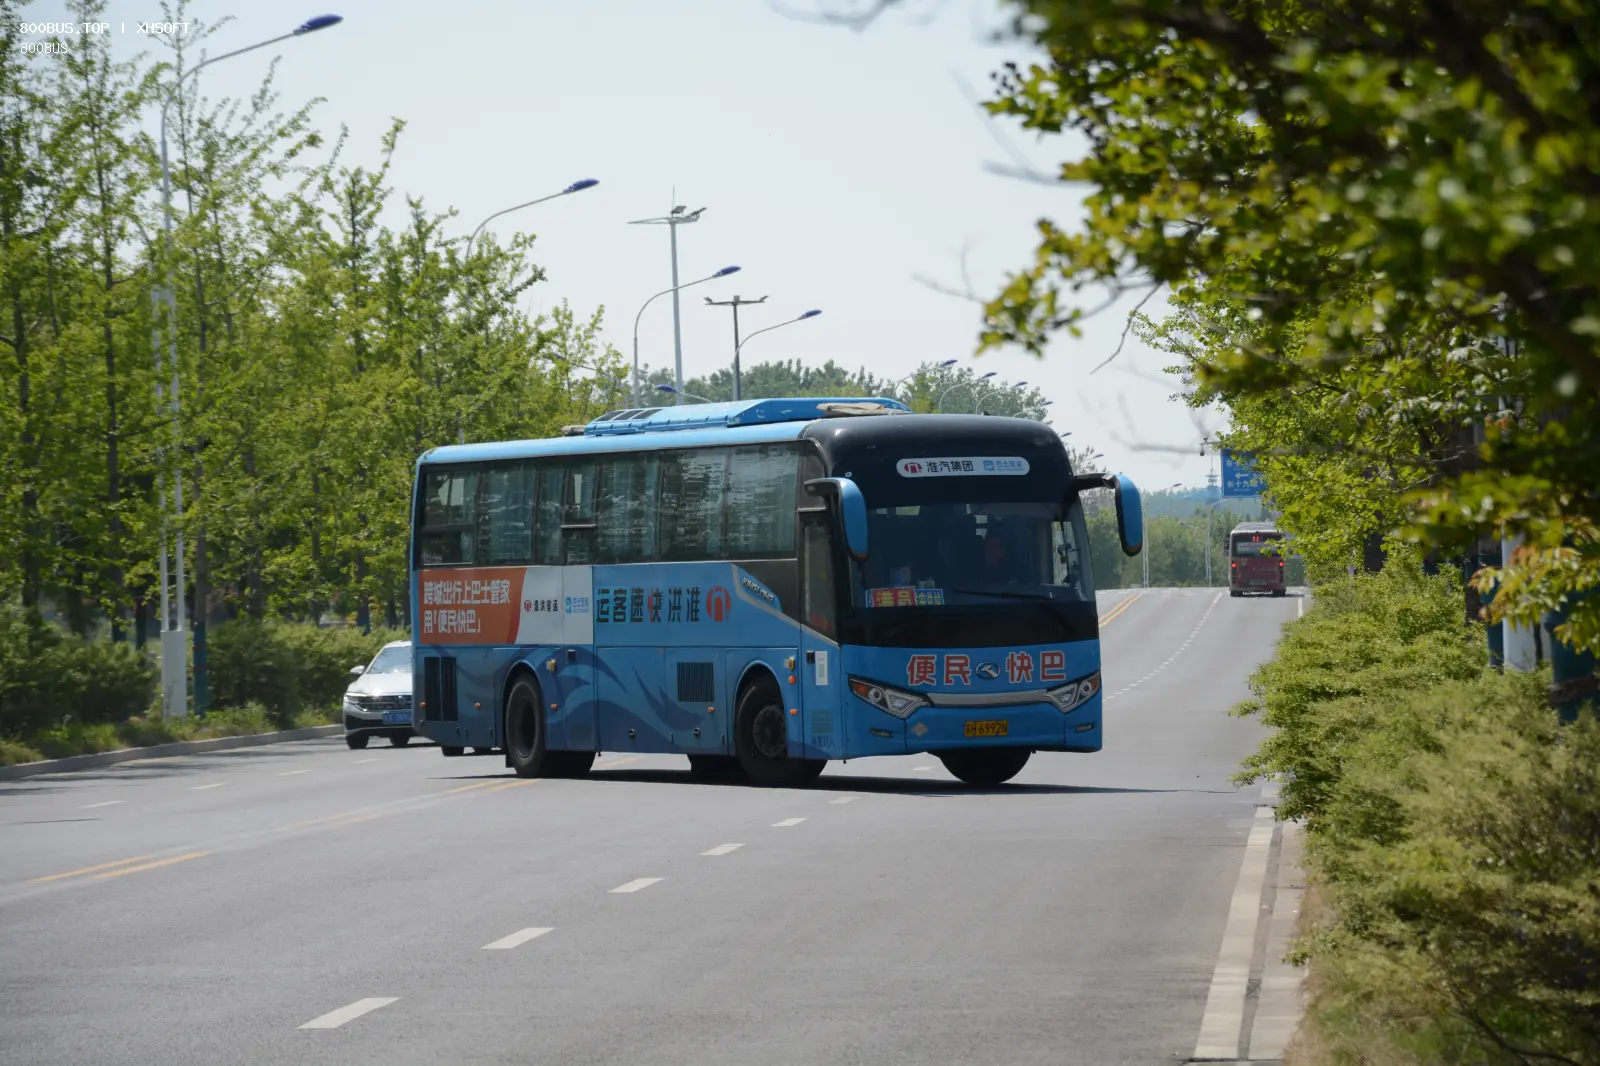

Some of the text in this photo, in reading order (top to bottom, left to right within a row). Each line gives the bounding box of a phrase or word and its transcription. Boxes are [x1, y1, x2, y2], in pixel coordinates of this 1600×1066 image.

[926, 460, 974, 473] 淮汽集团
[423, 579, 511, 605] 跨城出行上巴士管家
[907, 650, 1067, 686] 便民 快巴
